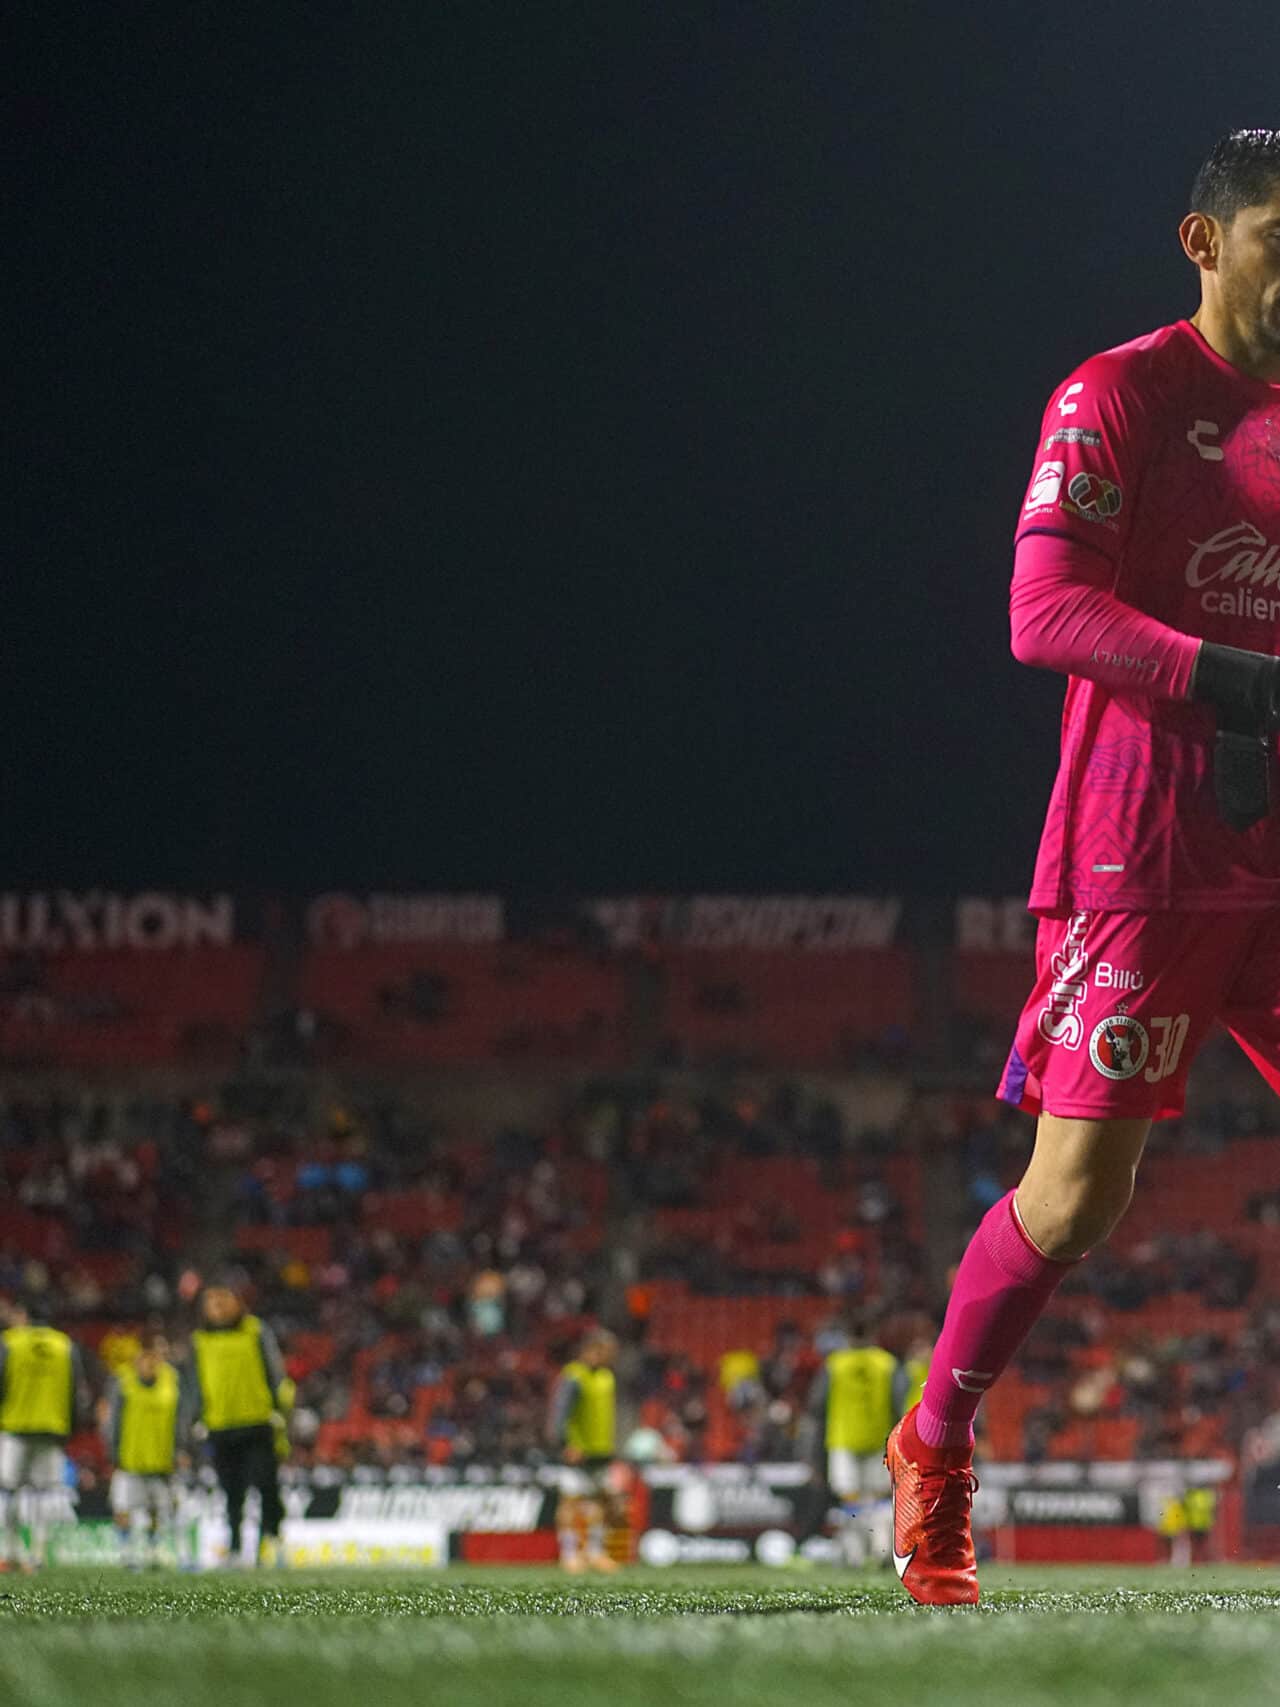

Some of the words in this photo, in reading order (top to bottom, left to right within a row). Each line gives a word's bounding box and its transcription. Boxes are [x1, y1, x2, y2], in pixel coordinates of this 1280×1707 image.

[1090, 650, 1160, 673] CHARLY
[1039, 910, 1092, 1050] SuKrn
[1094, 962, 1144, 990] Billú
[1144, 1013, 1190, 1083] 30
